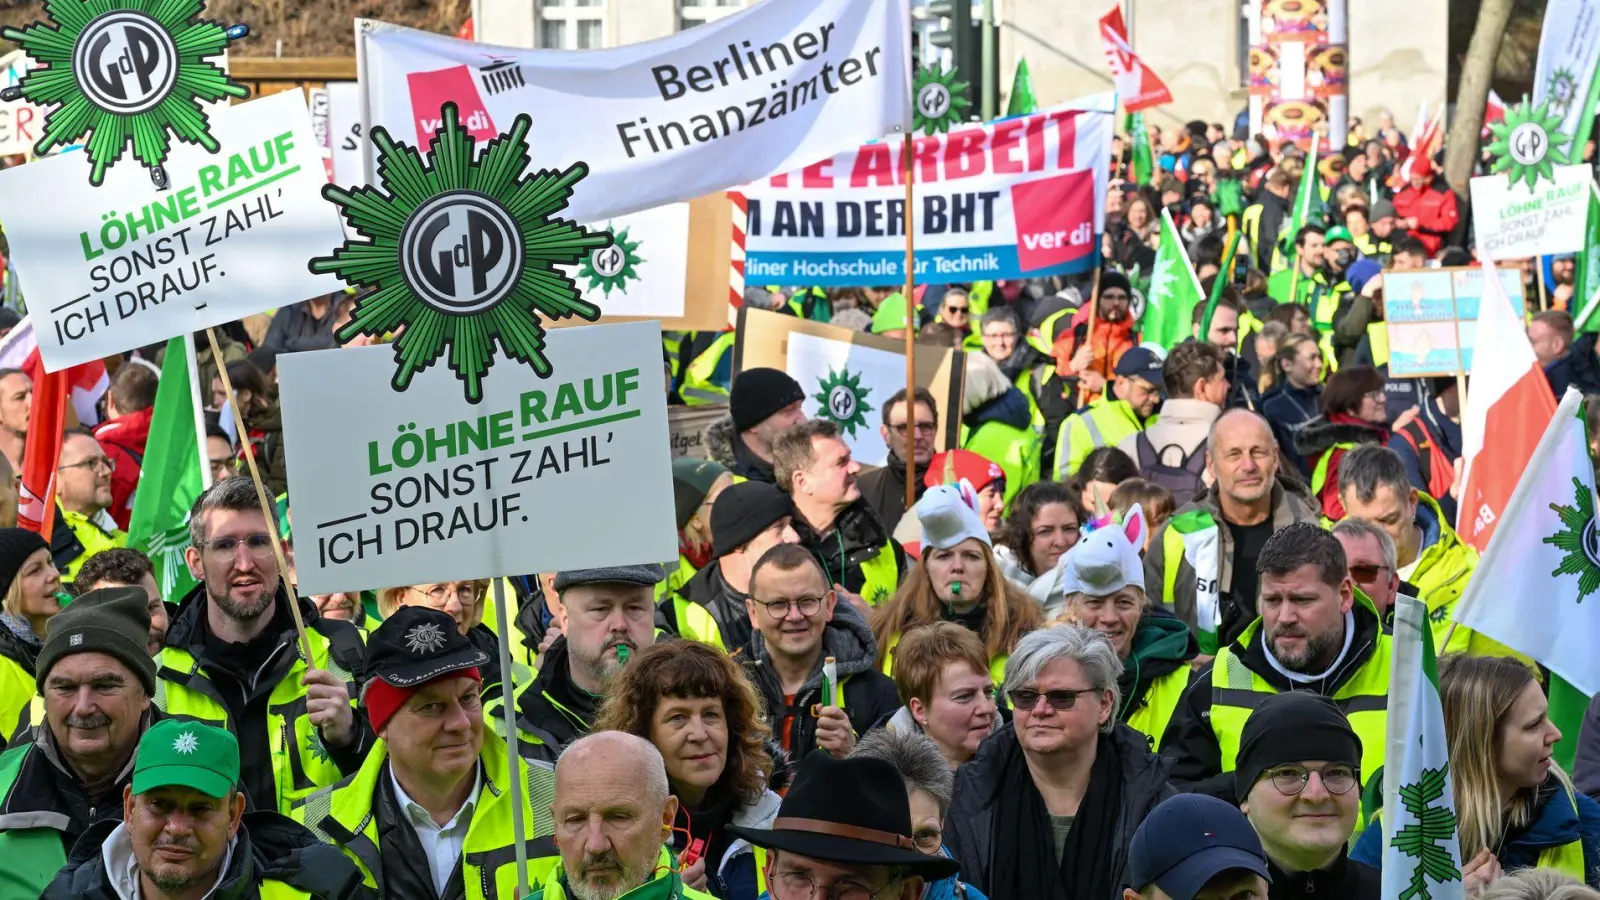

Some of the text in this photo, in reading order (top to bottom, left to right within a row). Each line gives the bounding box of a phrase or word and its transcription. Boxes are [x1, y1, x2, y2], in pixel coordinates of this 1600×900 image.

[651, 22, 835, 101] Berliner
[616, 47, 881, 158] Finanzämter
[850, 109, 1085, 188] ARBEIT
[80, 131, 299, 261] LÖHNE RAUF
[771, 200, 826, 238] AN
[836, 198, 907, 237] DER
[922, 191, 1000, 235] BHT
[89, 228, 192, 293] SONST
[745, 257, 788, 276] liner
[792, 257, 898, 277] Hochschule
[932, 253, 999, 273] Technik
[1022, 222, 1091, 250] ver.di
[53, 253, 226, 346] ICH DRAUF.
[368, 368, 640, 477] LÖHNE RAUF
[370, 457, 499, 515] SONST
[318, 492, 530, 569] ICH DRAUF.
